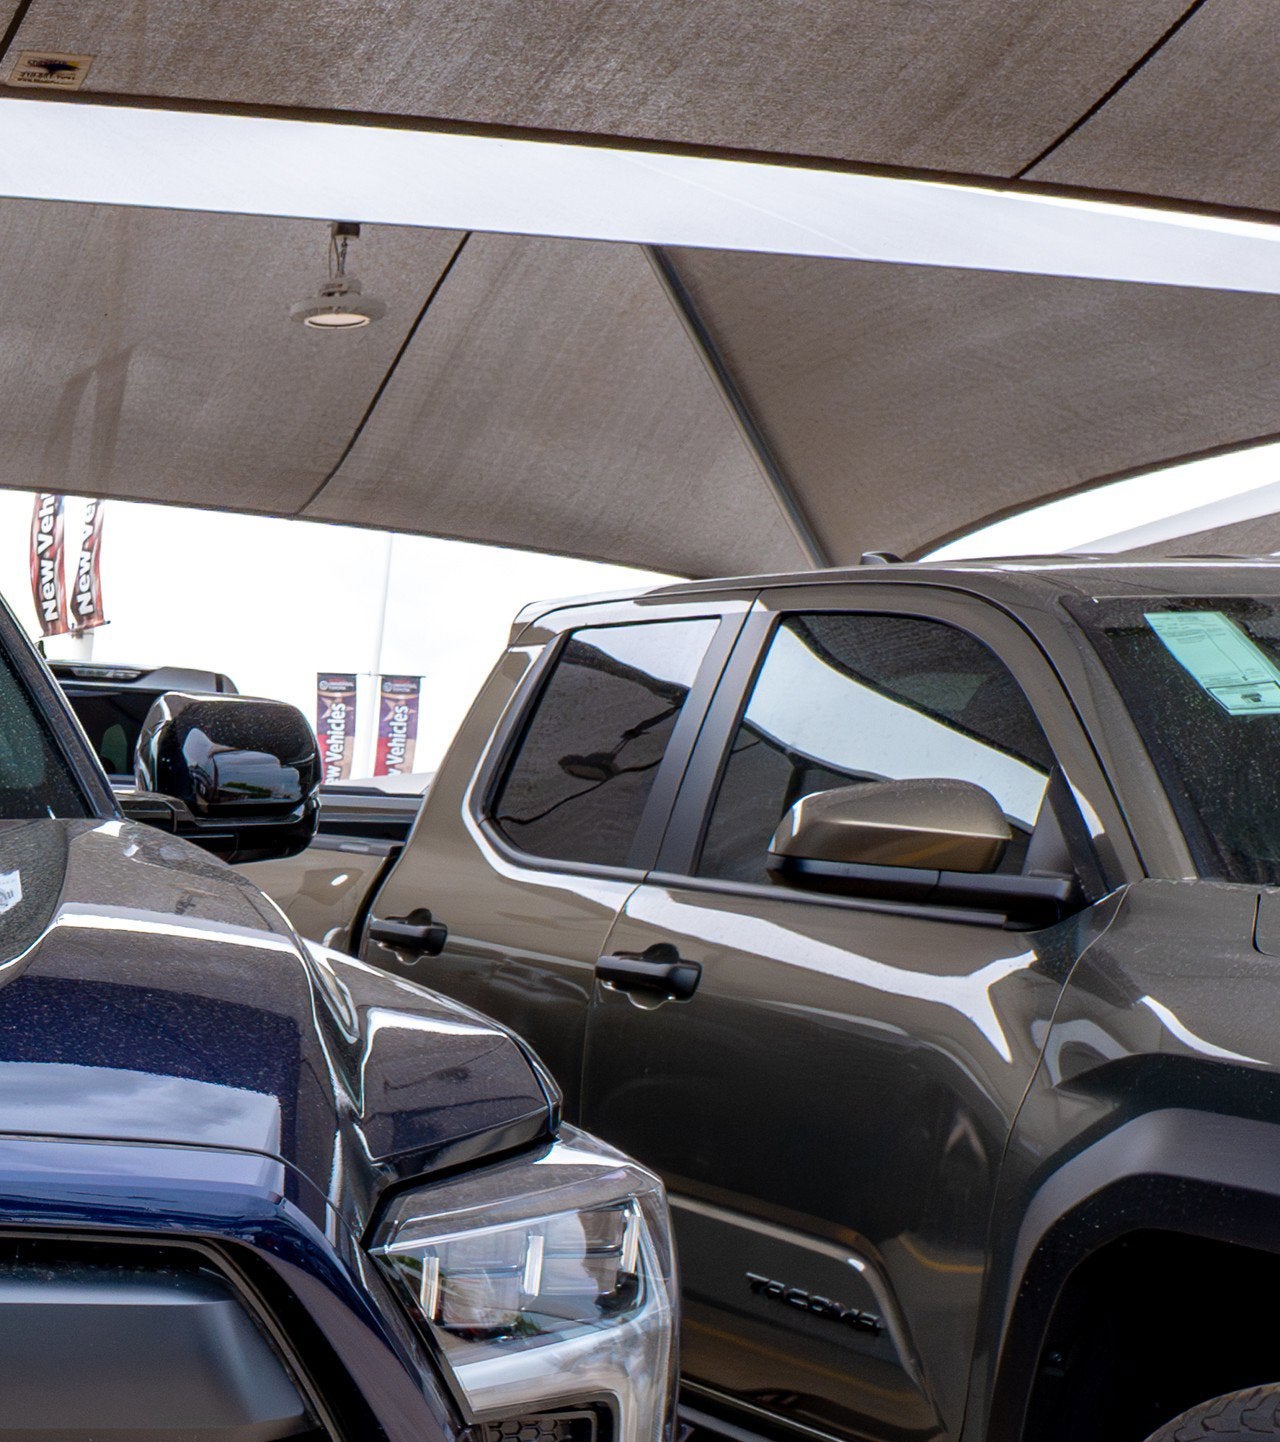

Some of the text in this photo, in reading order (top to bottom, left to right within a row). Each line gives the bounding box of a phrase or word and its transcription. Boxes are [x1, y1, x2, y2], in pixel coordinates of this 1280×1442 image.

[41, 560, 59, 621] New
[76, 550, 94, 615] New
[325, 703, 346, 763] Vehicles
[385, 705, 409, 765] Vehicles
[325, 765, 342, 784] ew
